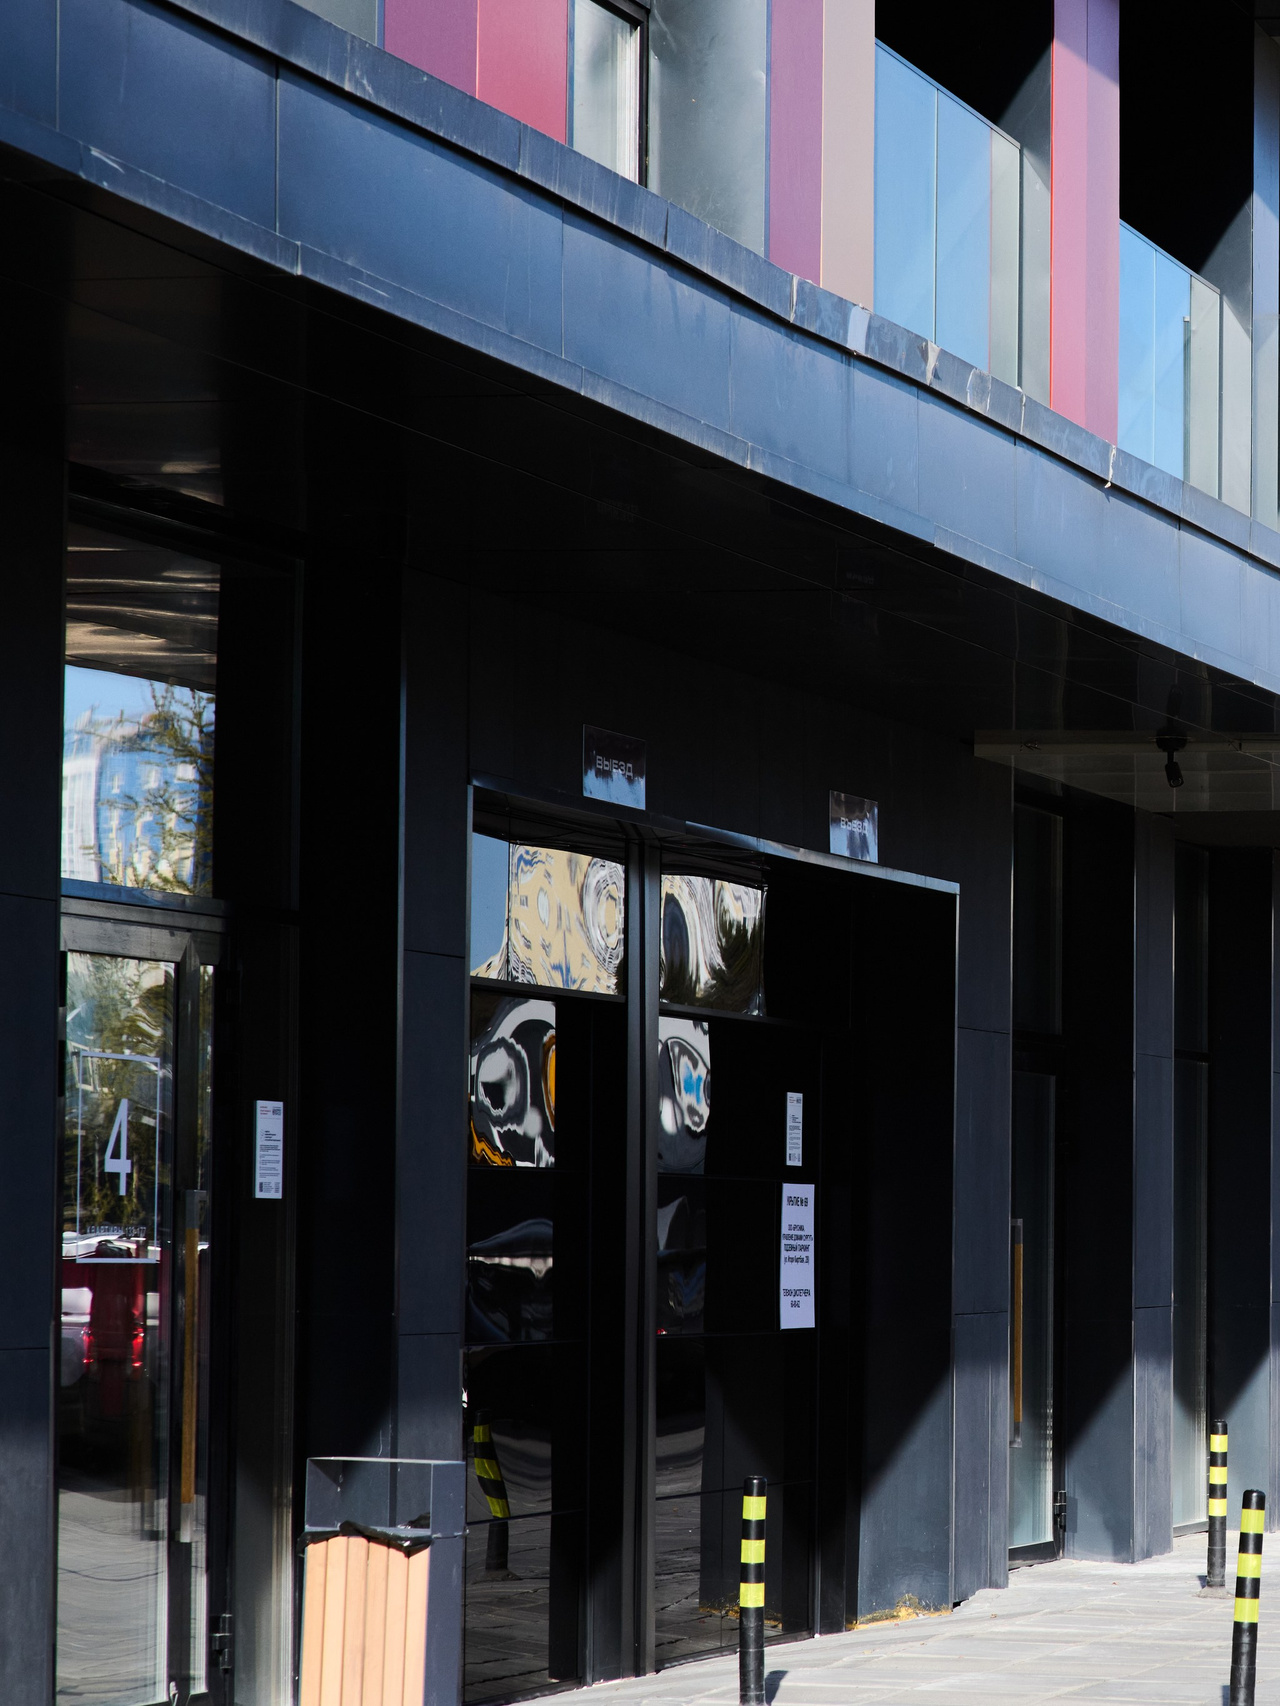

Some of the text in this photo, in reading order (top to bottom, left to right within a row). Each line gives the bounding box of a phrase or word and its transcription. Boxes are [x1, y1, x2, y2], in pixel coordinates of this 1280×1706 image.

[596, 755, 633, 779] ВЫЕЗД
[840, 816, 868, 837] ВЪЕЗД
[104, 1098, 131, 1196] 4
